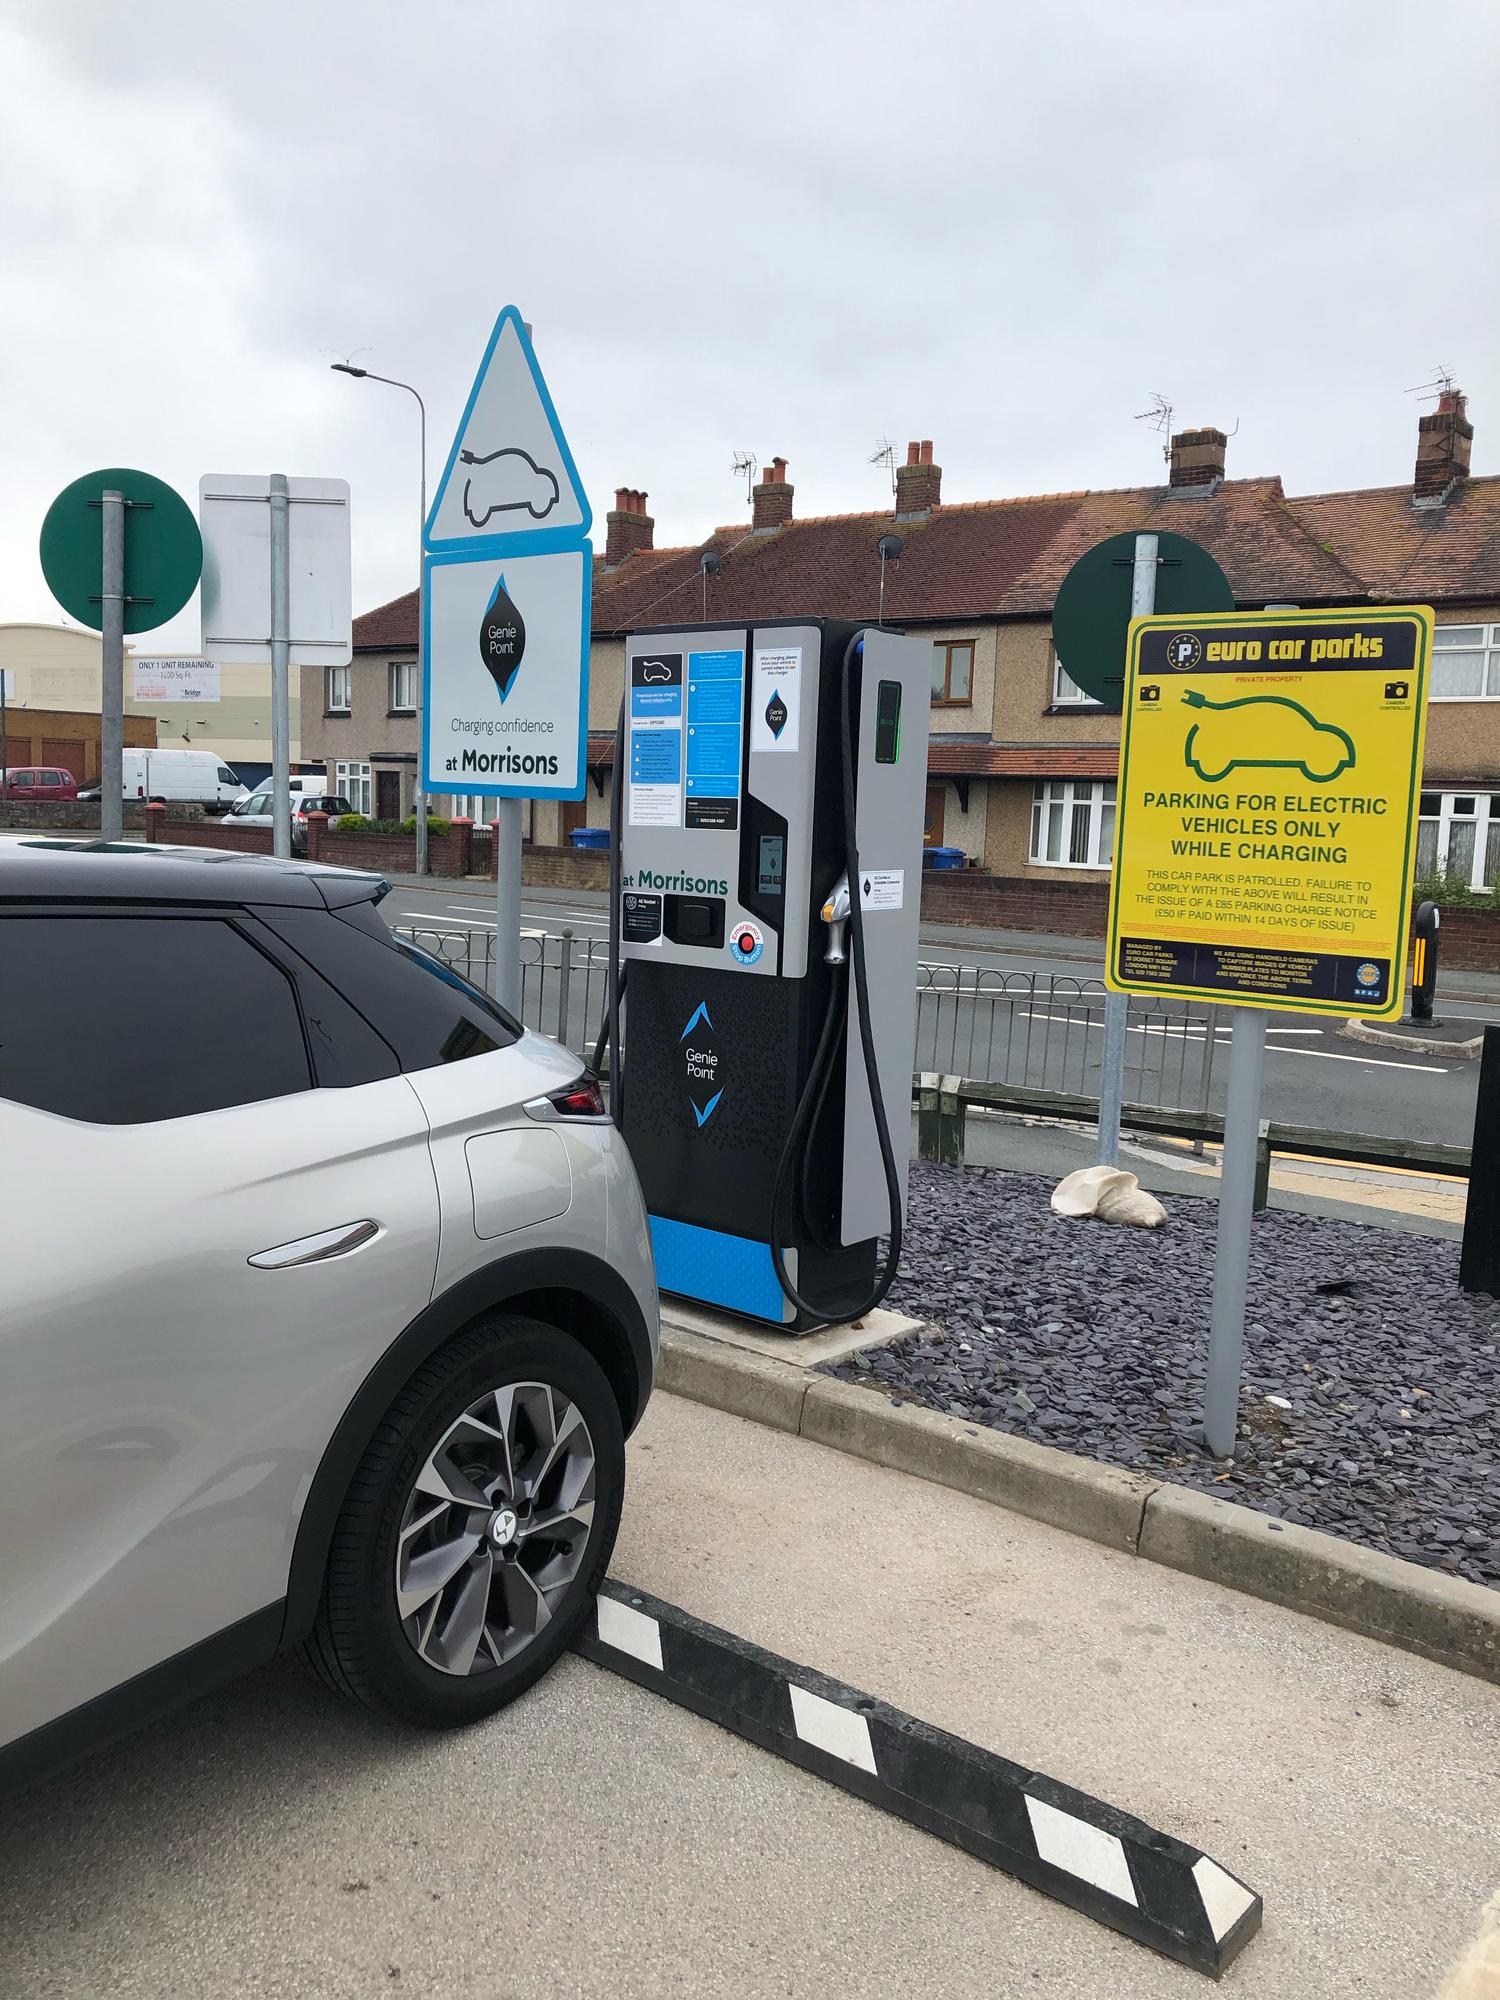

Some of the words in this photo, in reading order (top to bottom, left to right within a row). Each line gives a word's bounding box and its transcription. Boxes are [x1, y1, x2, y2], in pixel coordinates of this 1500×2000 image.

[488, 622, 517, 639] Genie
[489, 641, 514, 654] Point
[1178, 644, 1192, 661] P
[1206, 641, 1261, 661] euro
[1268, 640, 1306, 660] car
[1310, 633, 1383, 662] parks
[177, 661, 215, 669] REMAINING
[184, 689, 202, 697] Bridge
[769, 708, 784, 716] Genie
[451, 718, 493, 736] Charging
[495, 718, 554, 732] confidence
[446, 756, 458, 771] at
[462, 745, 559, 775] Morrisons
[1143, 793, 1229, 809] PARKING
[1236, 795, 1277, 811] FOR
[1283, 796, 1388, 815] ELECTRIC
[1181, 817, 1278, 836] VEHICLES
[1284, 820, 1341, 838] ONLY
[1171, 840, 1232, 858] WHILE
[1238, 843, 1348, 864] CHARGING
[623, 875, 634, 886] at
[639, 870, 728, 895] Morrisons
[1146, 870, 1169, 880] THIS
[1171, 871, 1193, 881] CAR
[1195, 872, 1223, 883] PARK
[1225, 874, 1236, 883] IS
[1238, 875, 1303, 888] PATROLLED.
[1307, 879, 1352, 890] FAILURE
[1356, 881, 1372, 892] TO
[1147, 882, 1189, 893] COMPLY
[1191, 885, 1217, 895] WITH
[1220, 886, 1240, 896] THE
[1243, 888, 1280, 899] ABOVE
[1282, 891, 1307, 901] WILL
[1310, 893, 1355, 904] RESULT
[1357, 895, 1368, 905] IN
[1135, 894, 1155, 904] THE
[1157, 896, 1187, 906] ISSUE
[1189, 898, 1203, 907] OF
[1205, 899, 1213, 908] A
[1215, 900, 1233, 909] £85
[1236, 901, 1282, 913] PARKING
[1285, 904, 1332, 916] CHARGE
[1335, 908, 1377, 920] NOTICE
[1154, 909, 1175, 918] (£50
[1177, 910, 1186, 918] IF
[1189, 911, 1213, 921] PAID
[1215, 913, 1251, 924] WITHIN
[1255, 914, 1266, 924] 14
[1268, 916, 1297, 927] DAYS
[1300, 918, 1316, 928] OF
[1318, 920, 1355, 933] ISSUE)
[732, 924, 761, 940] Emergency
[1227, 958, 1254, 966] CAPTURE
[1287, 963, 1313, 971] VEHICLE
[1256, 953, 1287, 962] HANDHELD
[1289, 956, 1318, 965] CAMERAS
[1229, 971, 1256, 980] ENFORCE
[1271, 975, 1291, 983] ABOVE
[1292, 977, 1313, 985] TERMS
[1247, 966, 1270, 974] PLATES
[1280, 969, 1308, 977] MONITOR
[1251, 980, 1287, 989] CONDITIONS
[686, 1048, 718, 1066] Genie
[687, 1063, 715, 1081] Point
